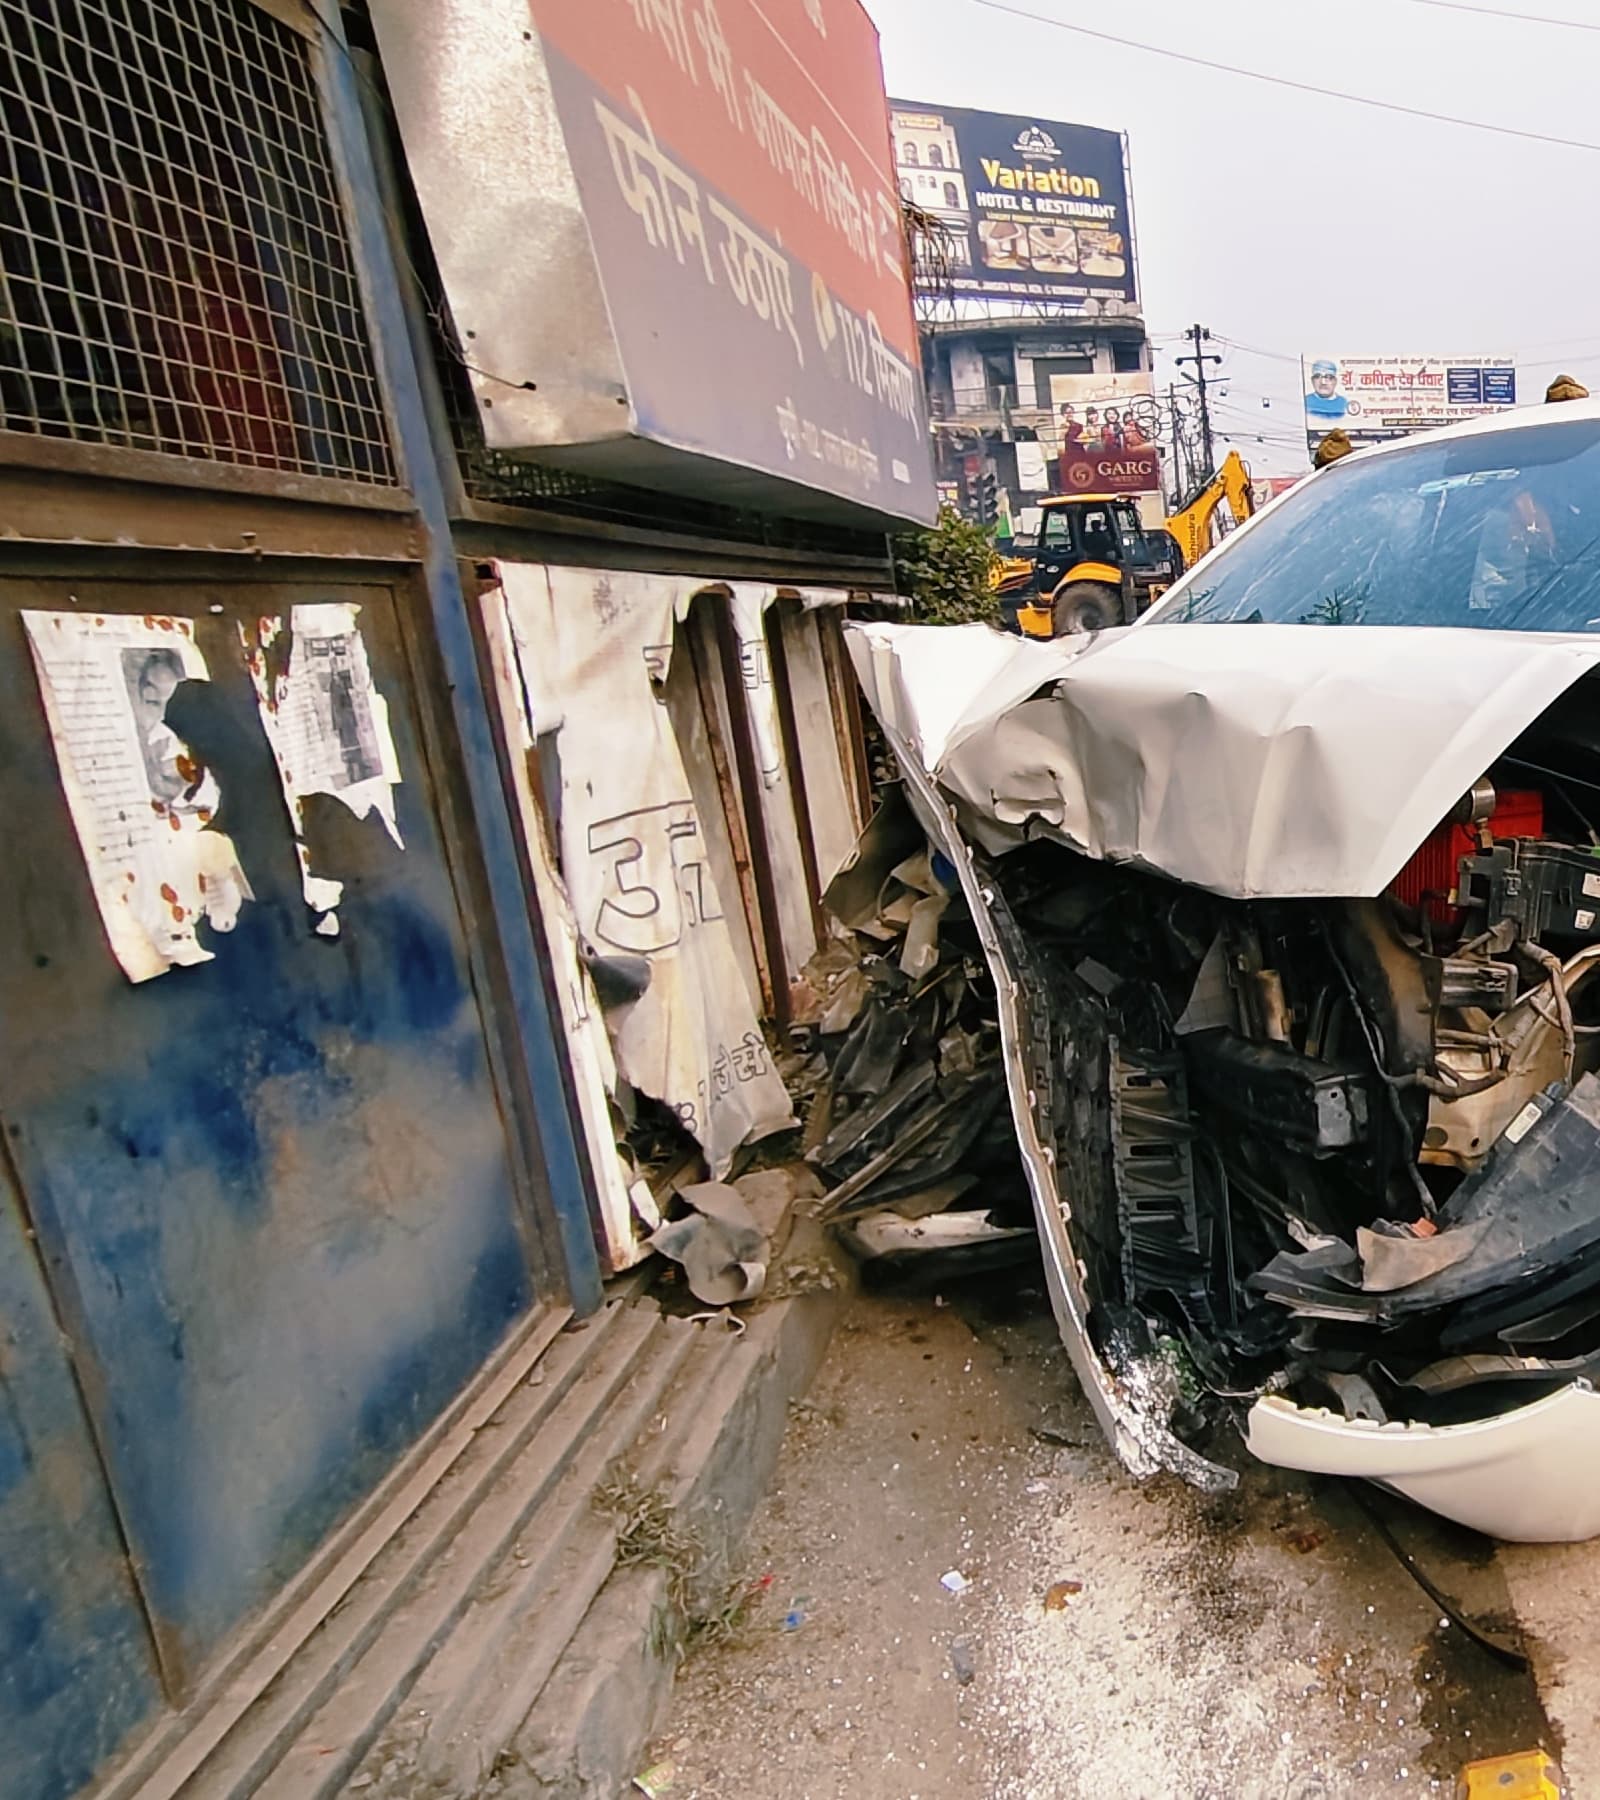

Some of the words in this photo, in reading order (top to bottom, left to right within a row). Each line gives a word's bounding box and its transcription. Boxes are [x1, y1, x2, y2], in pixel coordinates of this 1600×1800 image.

[980, 157, 1101, 198] Variation
[975, 191, 1020, 211] HOTEL
[1021, 195, 1034, 212] &
[1035, 197, 1117, 219] RESTAURANT
[593, 84, 716, 285] फोन
[706, 194, 804, 368] उठाएं
[835, 299, 874, 395] 112
[1360, 370, 1395, 385] कपिल
[1097, 460, 1152, 477] GARG
